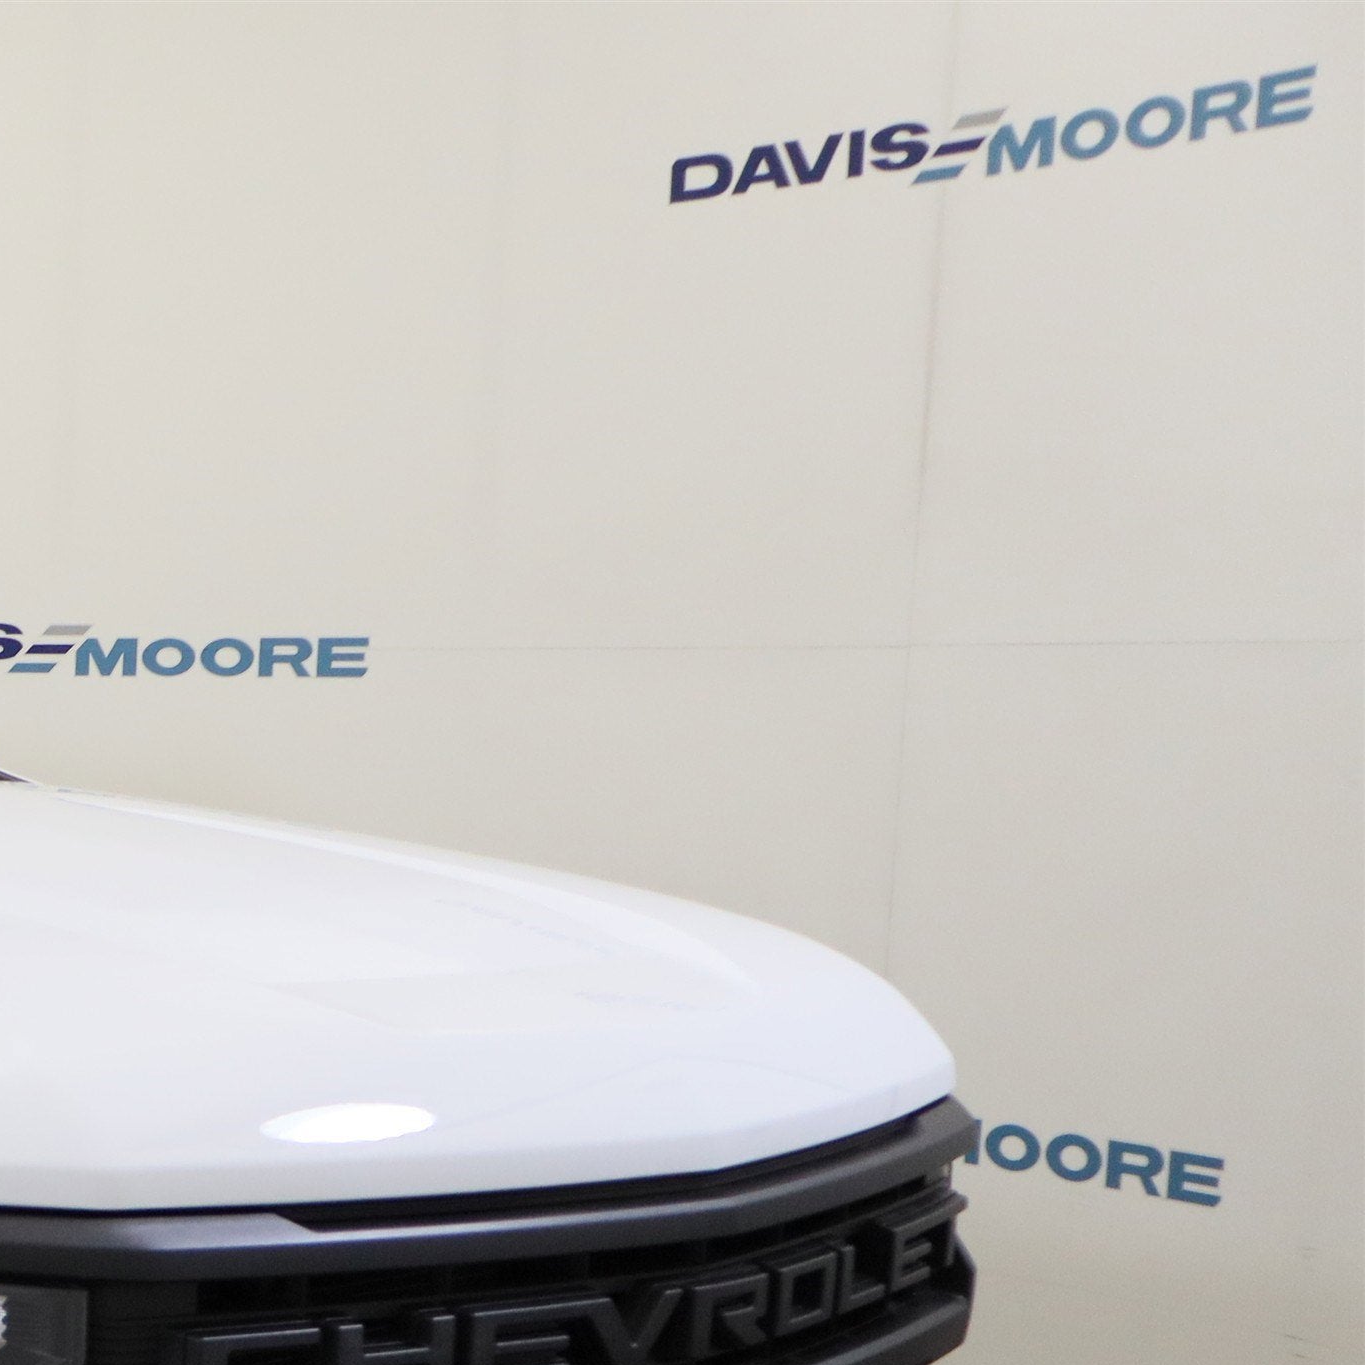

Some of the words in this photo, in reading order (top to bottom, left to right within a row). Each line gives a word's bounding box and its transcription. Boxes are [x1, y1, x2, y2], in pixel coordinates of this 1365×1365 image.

[669, 122, 933, 204] DAVIS
[985, 62, 1318, 177] MOORE
[75, 637, 369, 678] MOORE
